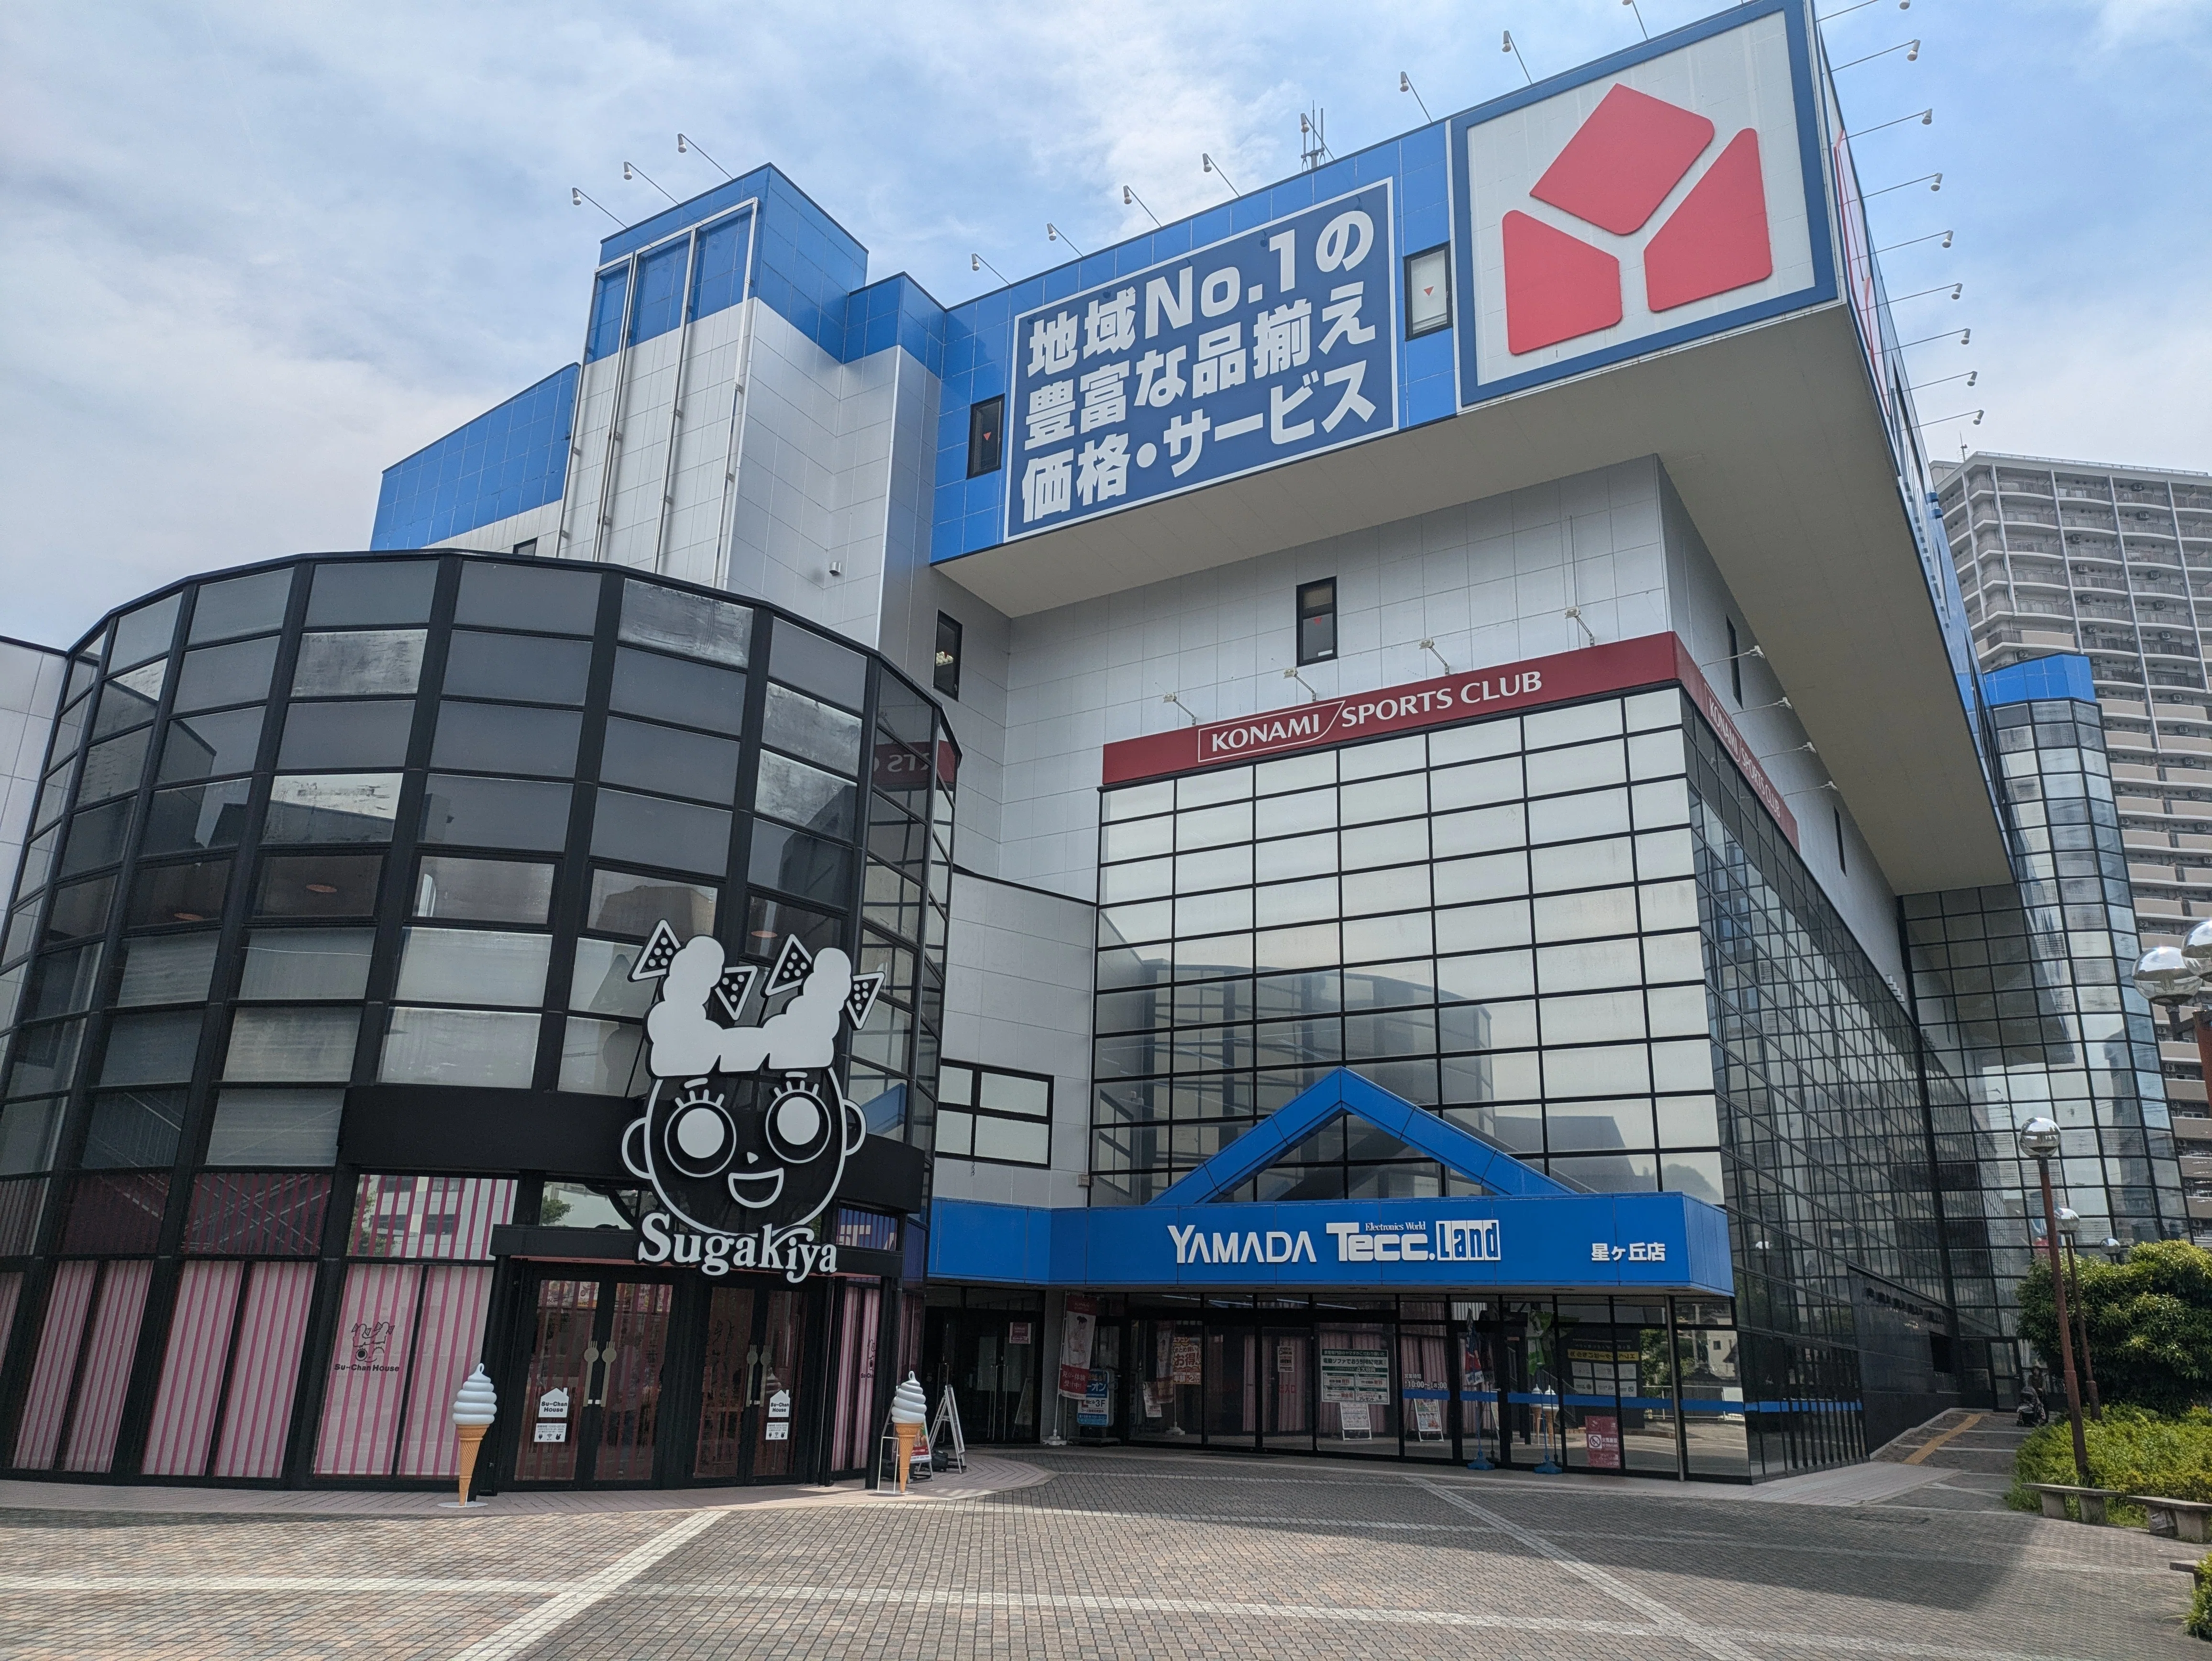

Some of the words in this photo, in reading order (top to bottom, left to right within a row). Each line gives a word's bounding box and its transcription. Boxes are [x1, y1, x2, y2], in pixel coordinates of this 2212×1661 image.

[1028, 210, 1374, 377] 地域No.1の
[1025, 282, 1375, 449] 豊富な品揃え
[1022, 360, 1376, 523] 価格・サービス
[1212, 714, 1319, 752] KONAMI
[1341, 687, 1452, 727] SPORTS
[1460, 671, 1542, 704] CLUB
[1709, 698, 1738, 755] KONAMI
[1741, 747, 1765, 795] SPORTS
[1765, 784, 1781, 818] CLUB
[638, 1212, 838, 1283] Sugakiya
[1167, 1225, 1317, 1263] YAMADA
[1365, 1223, 1404, 1231] Electronics
[1405, 1221, 1426, 1230] World
[1087, 1382, 1106, 1391] ーオン
